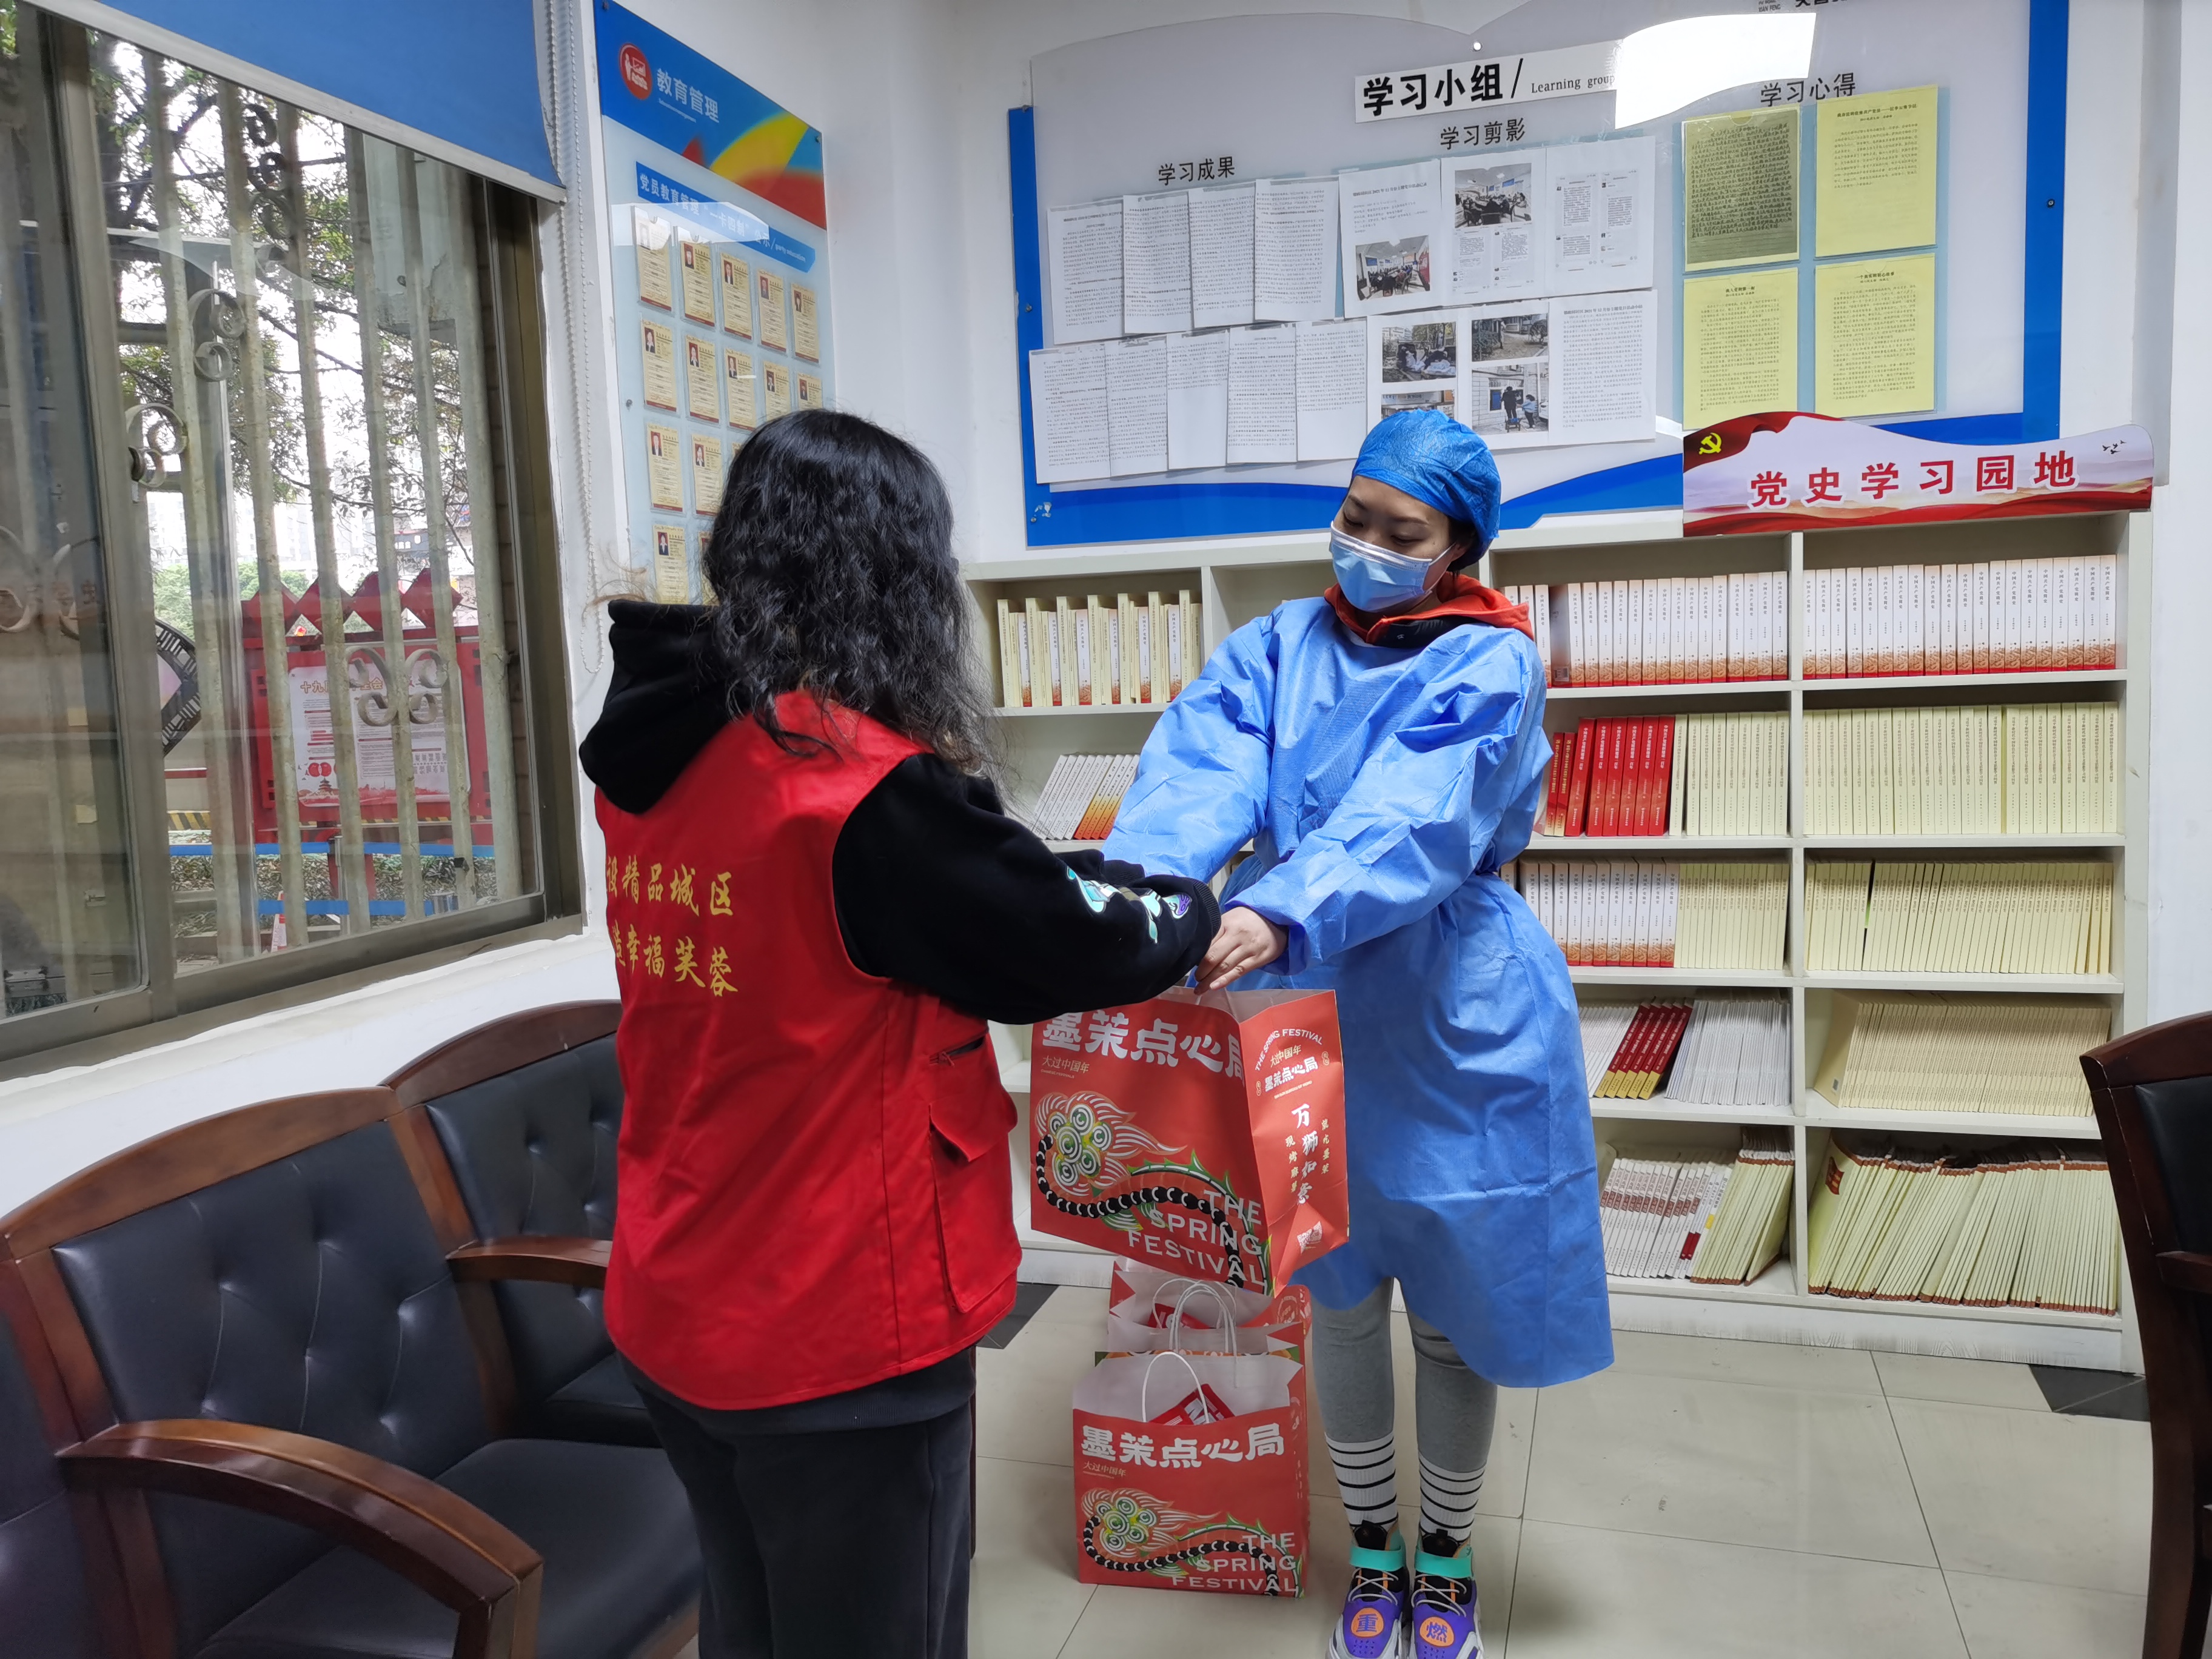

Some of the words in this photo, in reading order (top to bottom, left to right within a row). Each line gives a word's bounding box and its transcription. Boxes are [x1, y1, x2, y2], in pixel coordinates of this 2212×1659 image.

[657, 68, 720, 124] 教育管理
[1532, 79, 1581, 93] Learning
[1761, 72, 1856, 107] 学习心得
[1440, 117, 1526, 149] 学习剪影
[1158, 156, 1236, 186] 学习成果
[1751, 450, 2077, 509] 党史学习园地
[1042, 1009, 1245, 1087] 墨茉点心局
[1042, 1055, 1090, 1074] 大过中国年
[1255, 1050, 1265, 1071] THE
[1264, 1030, 1280, 1053] SPRING
[1282, 1028, 1322, 1045] FESTIVAL
[1270, 1044, 1301, 1068] 大过中国年
[1265, 1056, 1318, 1092] 墨茉点心局
[1292, 1103, 1318, 1205] 万狮如意
[1321, 1119, 1331, 1175] 就吃墨茉
[1204, 1189, 1262, 1225] THE
[1150, 1208, 1262, 1255] SPRING
[1128, 1230, 1266, 1285] FESTIVAL
[1081, 1423, 1284, 1468] 墨茉点心局
[1083, 1461, 1126, 1478] 大过中国年
[1242, 1532, 1295, 1549] THE
[1196, 1555, 1296, 1572] SPRING
[1172, 1577, 1298, 1592] FESTIVAL
